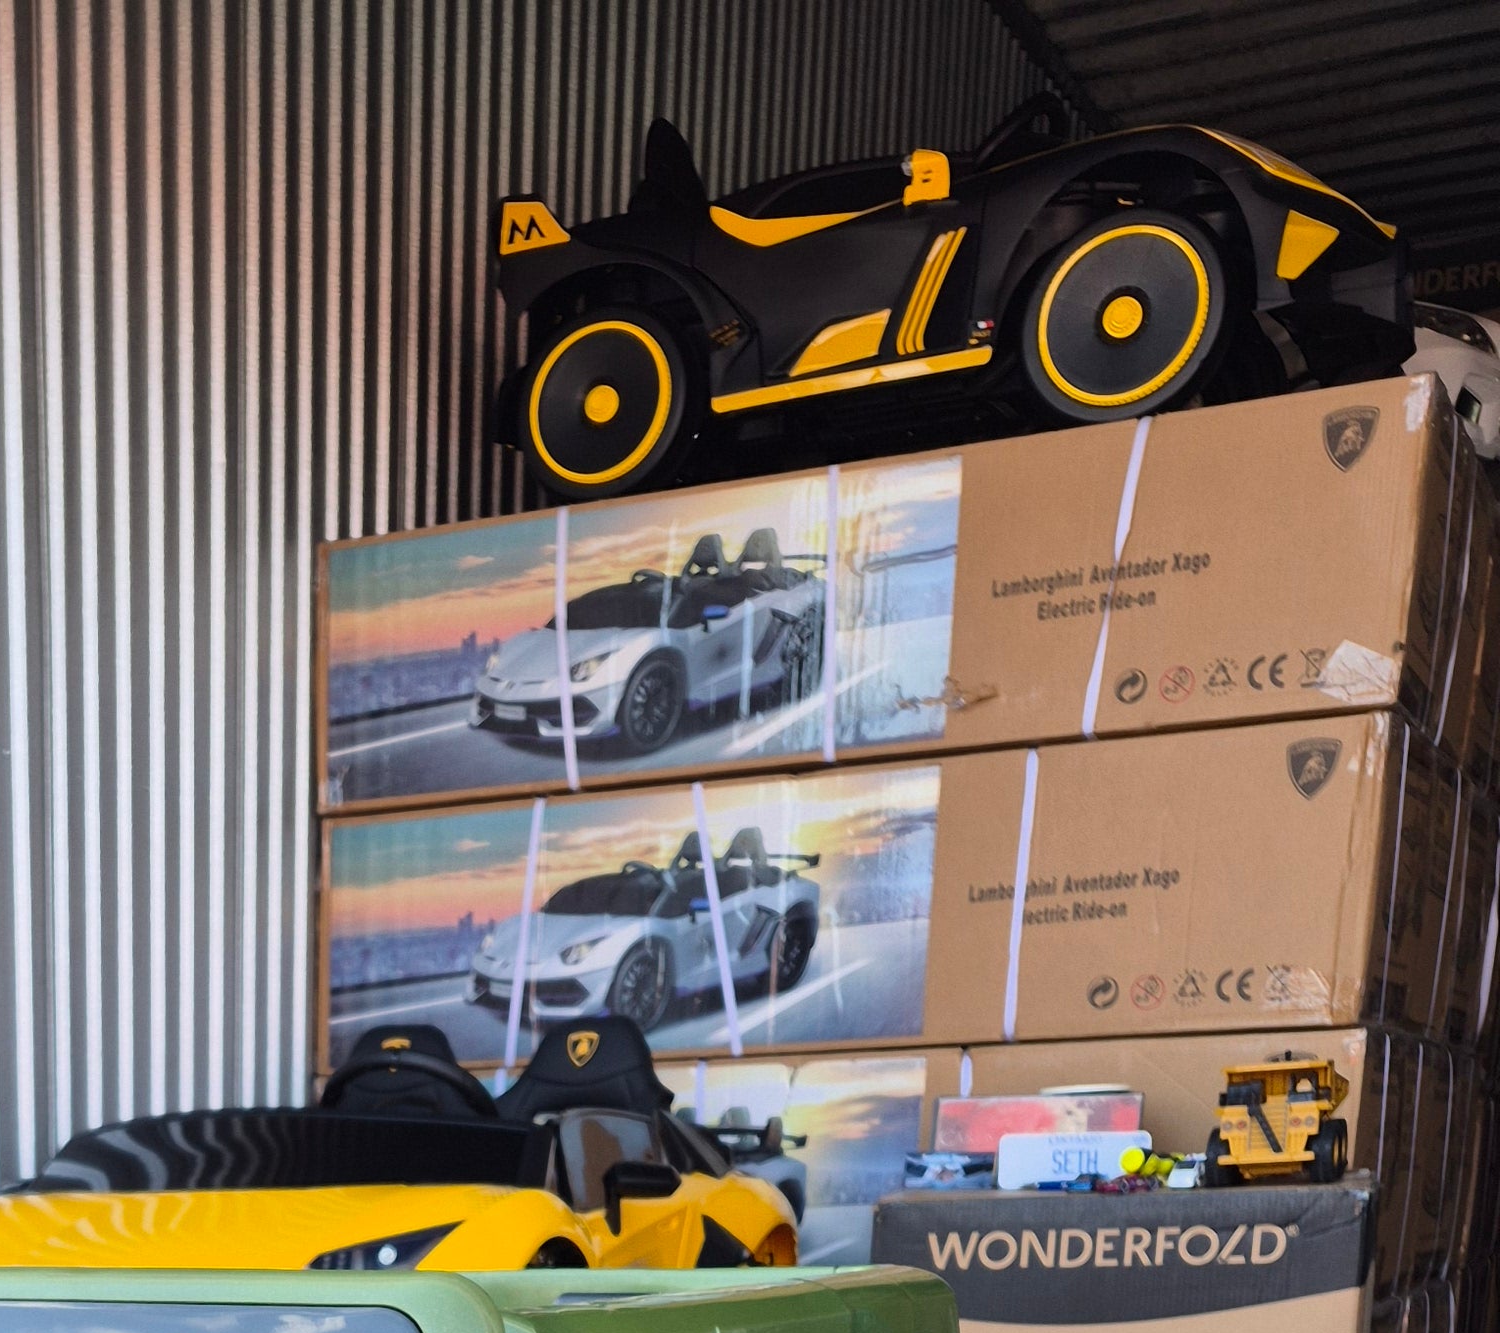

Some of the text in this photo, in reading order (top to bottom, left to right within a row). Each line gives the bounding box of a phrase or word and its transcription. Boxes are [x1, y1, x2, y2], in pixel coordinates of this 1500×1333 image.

[991, 567, 1084, 598] Lamborghini
[1171, 552, 1212, 575] Xago
[1036, 595, 1097, 621] Electric
[1063, 870, 1138, 895] Aventador
[1142, 867, 1181, 890] Xago
[1022, 899, 1128, 926] lectric Ride-on
[1051, 1148, 1099, 1175] SETH
[927, 1222, 1289, 1272] WONDERFOLD
